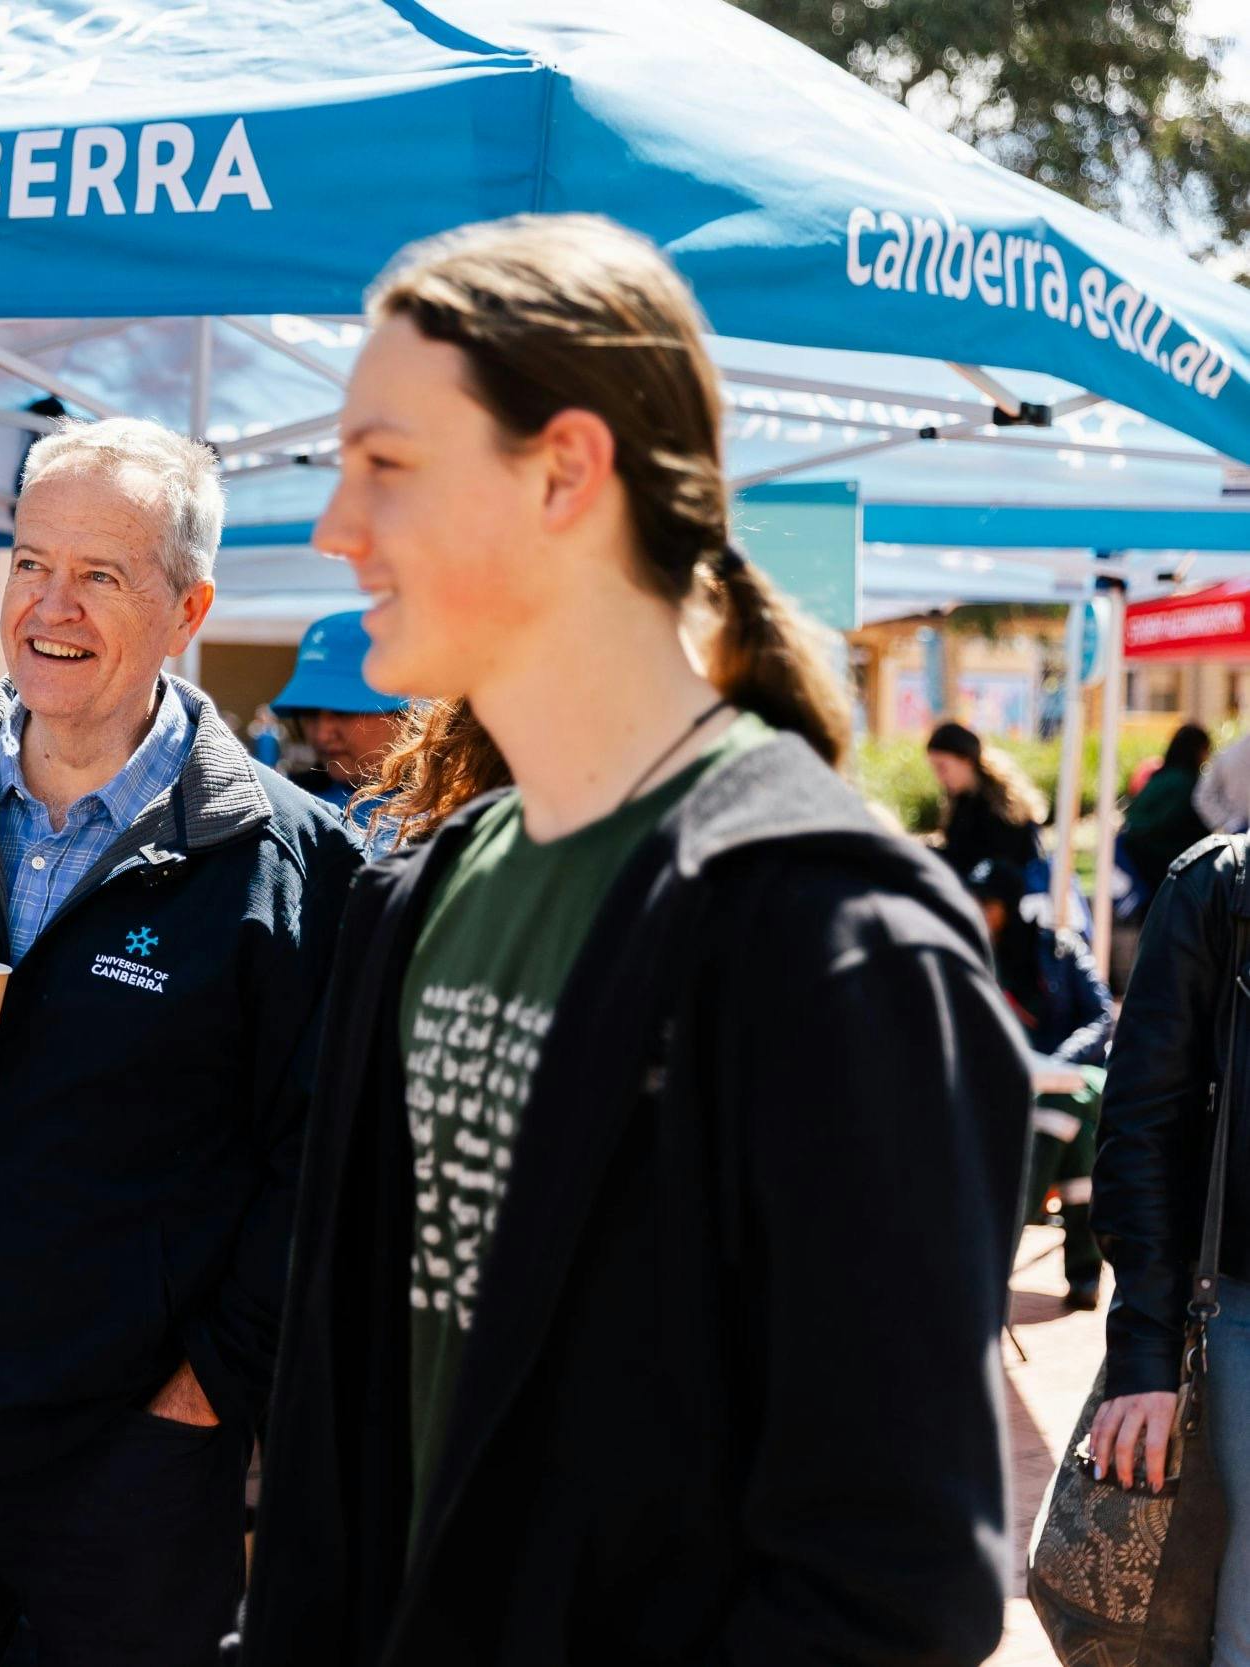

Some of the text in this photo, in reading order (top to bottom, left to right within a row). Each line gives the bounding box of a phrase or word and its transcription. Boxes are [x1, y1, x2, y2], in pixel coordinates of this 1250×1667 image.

[54, 4, 209, 46] OF
[846, 206, 1232, 399] canberra.edu.au
[91, 963, 164, 993] CANBERRA
[95, 954, 170, 982] UNIVERSITY OF
